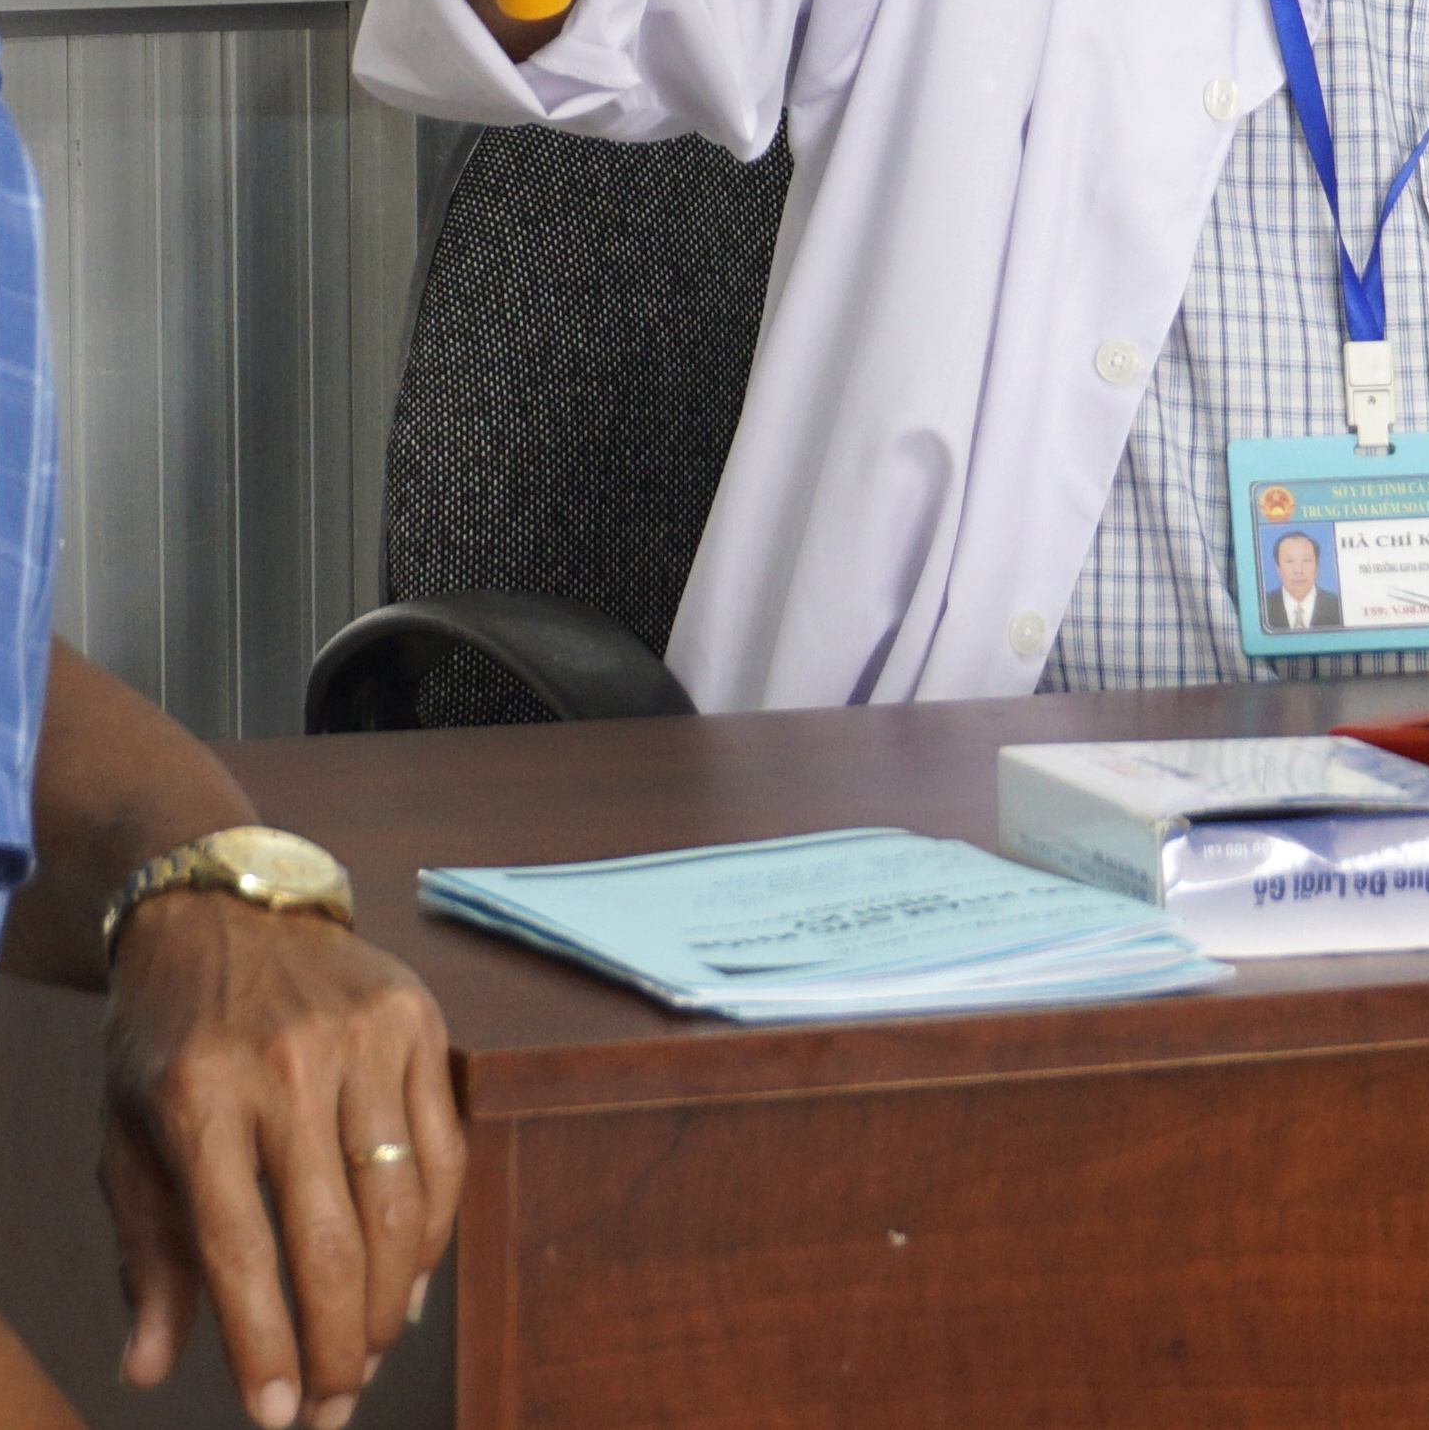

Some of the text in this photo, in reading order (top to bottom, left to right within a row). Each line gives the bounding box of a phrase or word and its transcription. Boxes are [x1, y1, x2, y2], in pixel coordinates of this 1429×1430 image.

[1301, 505, 1340, 519] TRUNG
[1343, 501, 1369, 517] TÂM
[1340, 533, 1369, 549] HÀ
[1375, 531, 1412, 547] CHÍ
[1225, 843, 1249, 857] 100
